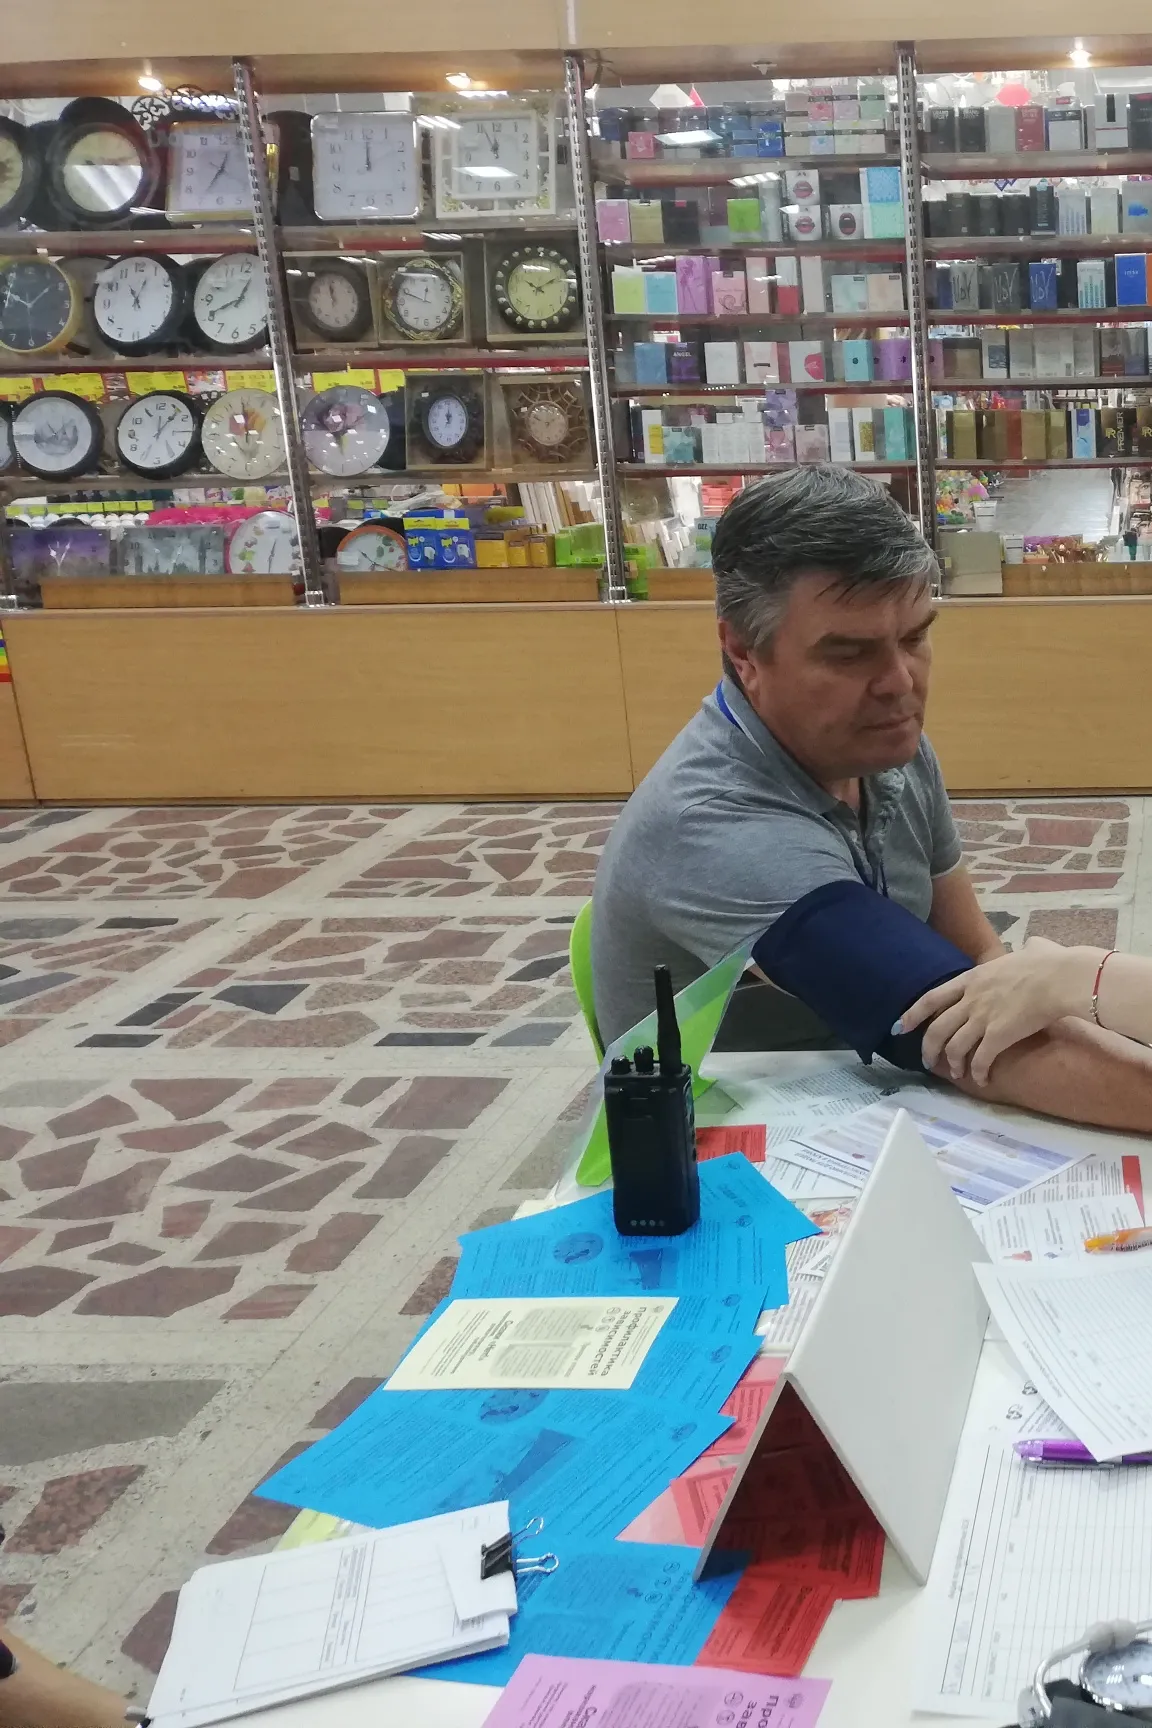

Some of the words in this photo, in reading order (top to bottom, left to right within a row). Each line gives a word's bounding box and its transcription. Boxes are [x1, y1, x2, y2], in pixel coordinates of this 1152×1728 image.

[492, 122, 501, 133] 12
[513, 122, 519, 132] 1
[522, 133, 529, 143] 2
[397, 140, 405, 152] 2
[523, 169, 530, 179] 4
[494, 181, 501, 191] 6
[135, 262, 146, 273] 12
[240, 261, 252, 273] 12
[120, 268, 128, 279] 11
[205, 293, 214, 307] 9
[218, 322, 225, 334] 7
[423, 318, 430, 327] 6
[231, 327, 240, 340] 6
[248, 323, 257, 335] 5
[9, 333, 16, 342] 7
[46, 331, 53, 341] 5
[156, 402, 167, 411] 12
[132, 417, 143, 426] 10
[181, 414, 189, 423] 2
[1116, 411, 1126, 452] PREMIER
[129, 443, 138, 452] 8
[587, 1310, 629, 1376] зависимостей
[600, 1306, 647, 1377] Профилактика
